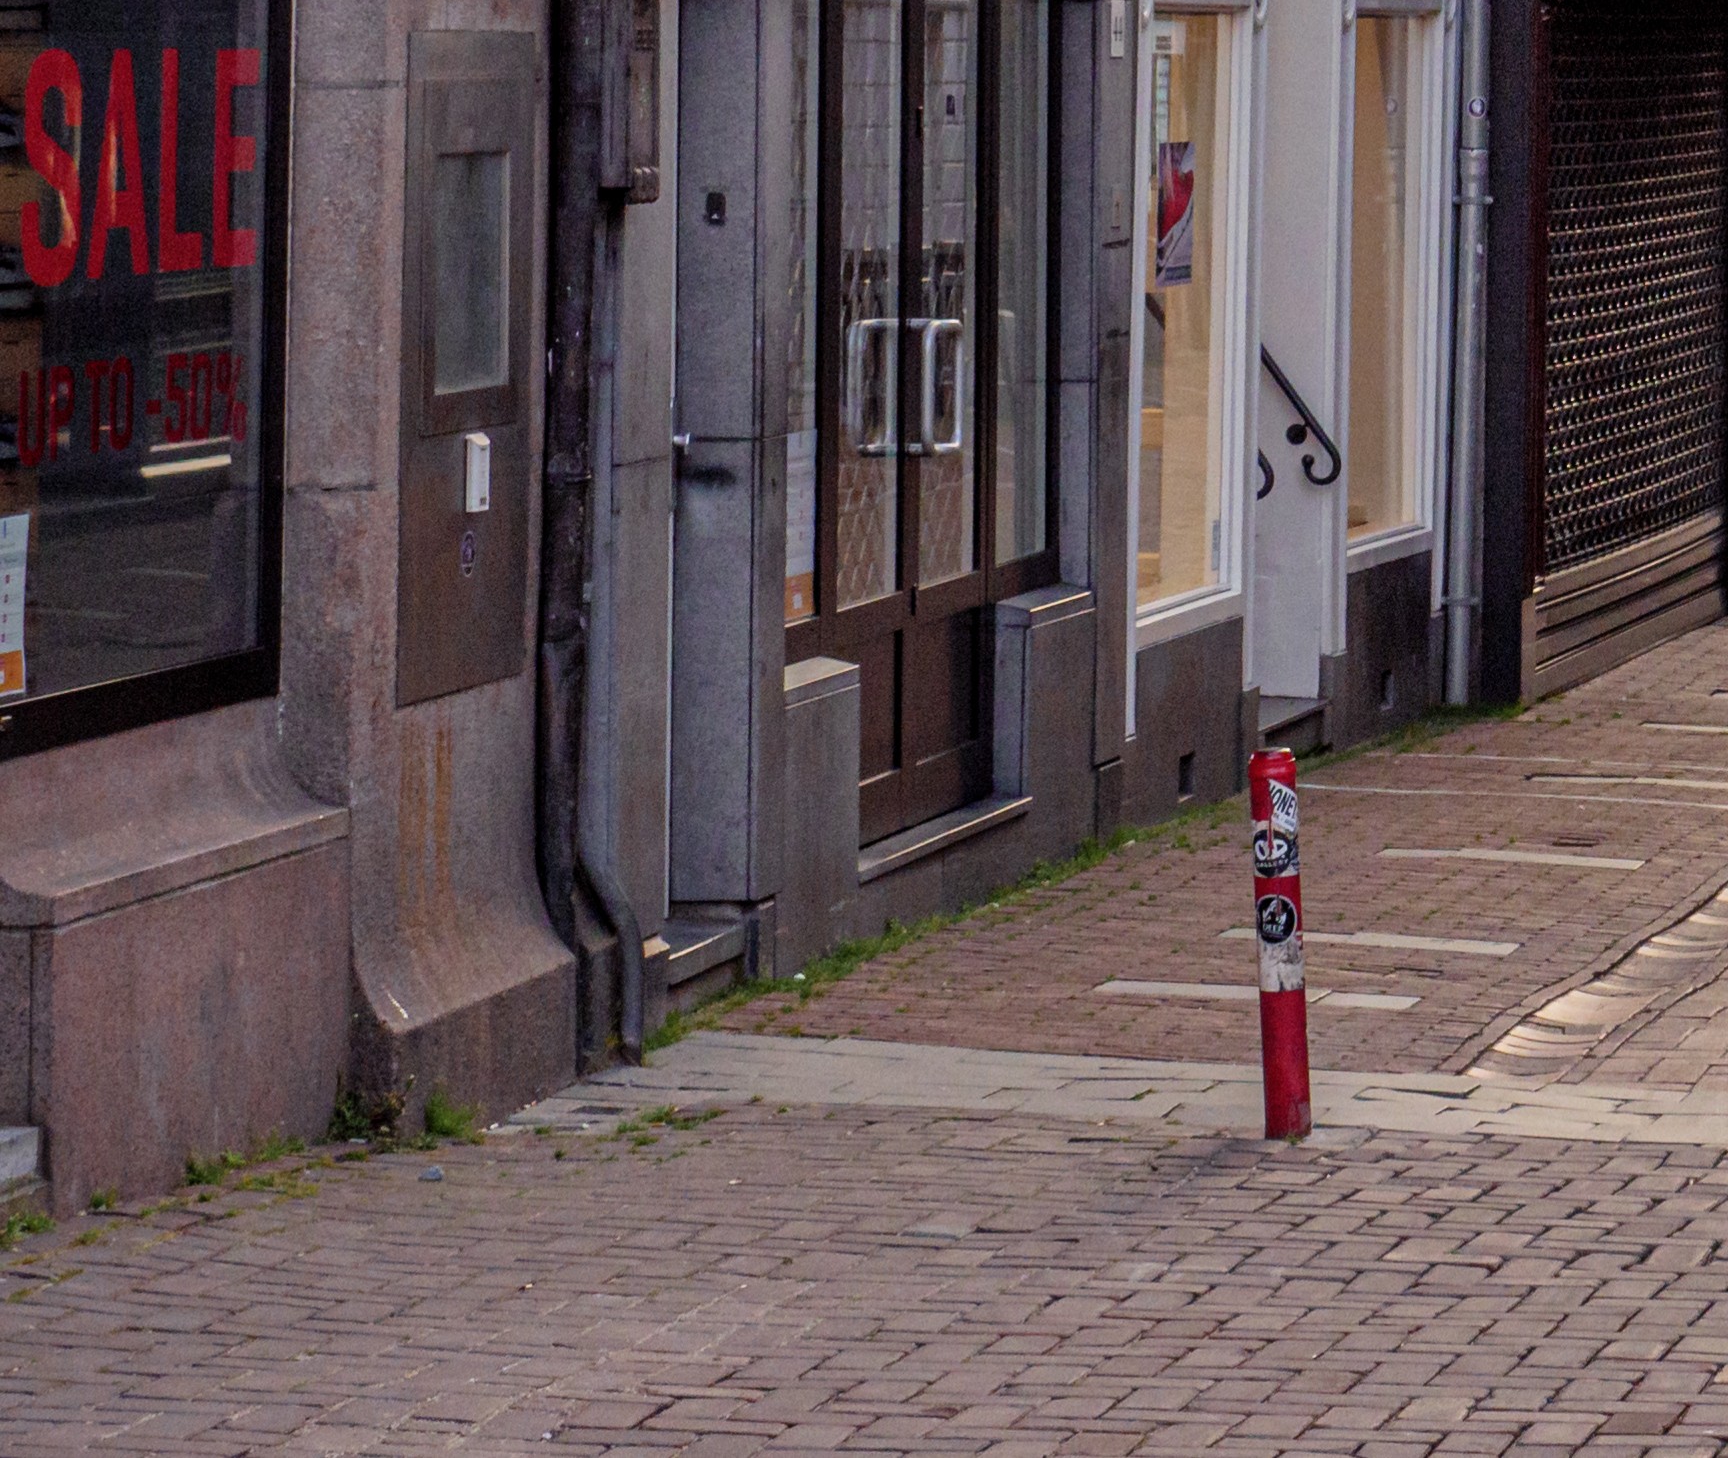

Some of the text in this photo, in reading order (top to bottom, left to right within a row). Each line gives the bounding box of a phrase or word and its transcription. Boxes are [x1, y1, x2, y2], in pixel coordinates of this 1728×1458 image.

[20, 47, 262, 288] SALE
[17, 352, 248, 468] UP TO -50%
